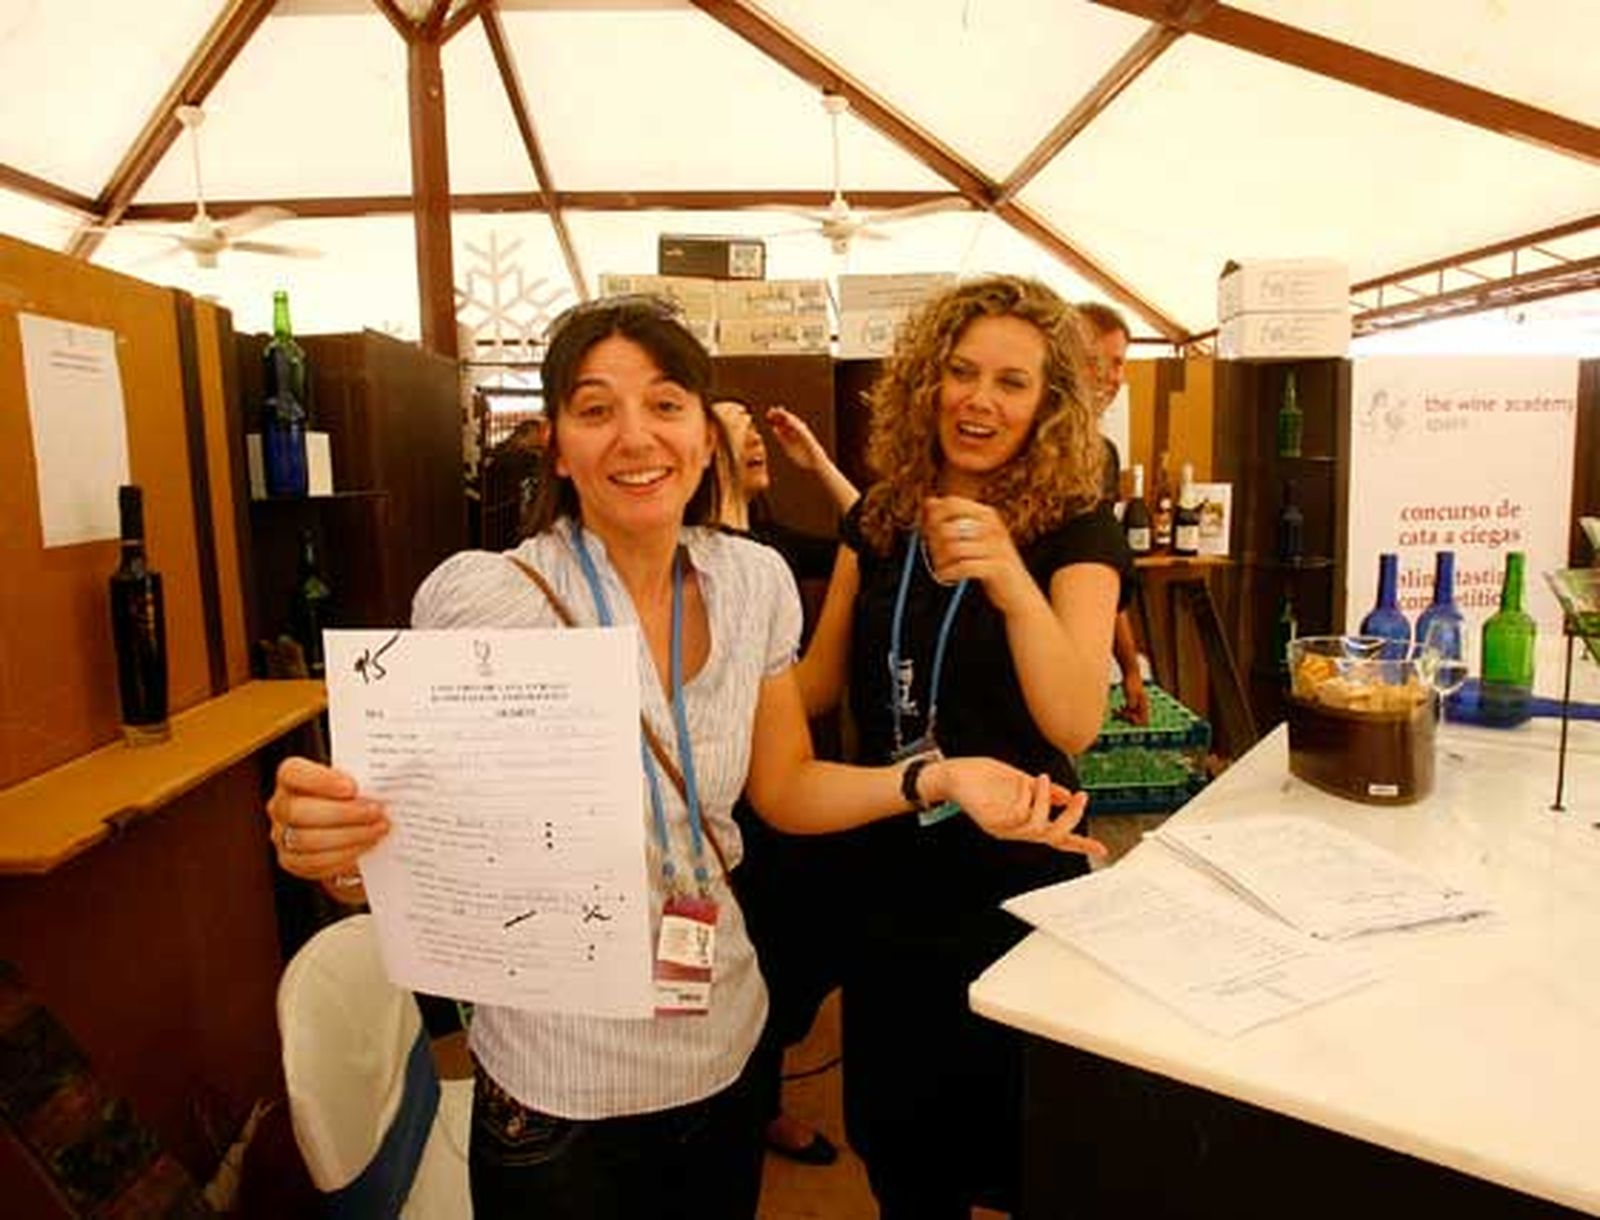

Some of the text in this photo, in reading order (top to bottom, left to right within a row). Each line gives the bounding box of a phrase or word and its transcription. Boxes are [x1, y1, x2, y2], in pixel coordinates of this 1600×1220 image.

[1425, 394, 1450, 412] the
[1457, 394, 1496, 412] wine
[1400, 499, 1522, 521] concurso de
[1399, 526, 1521, 548] cata a ciegas
